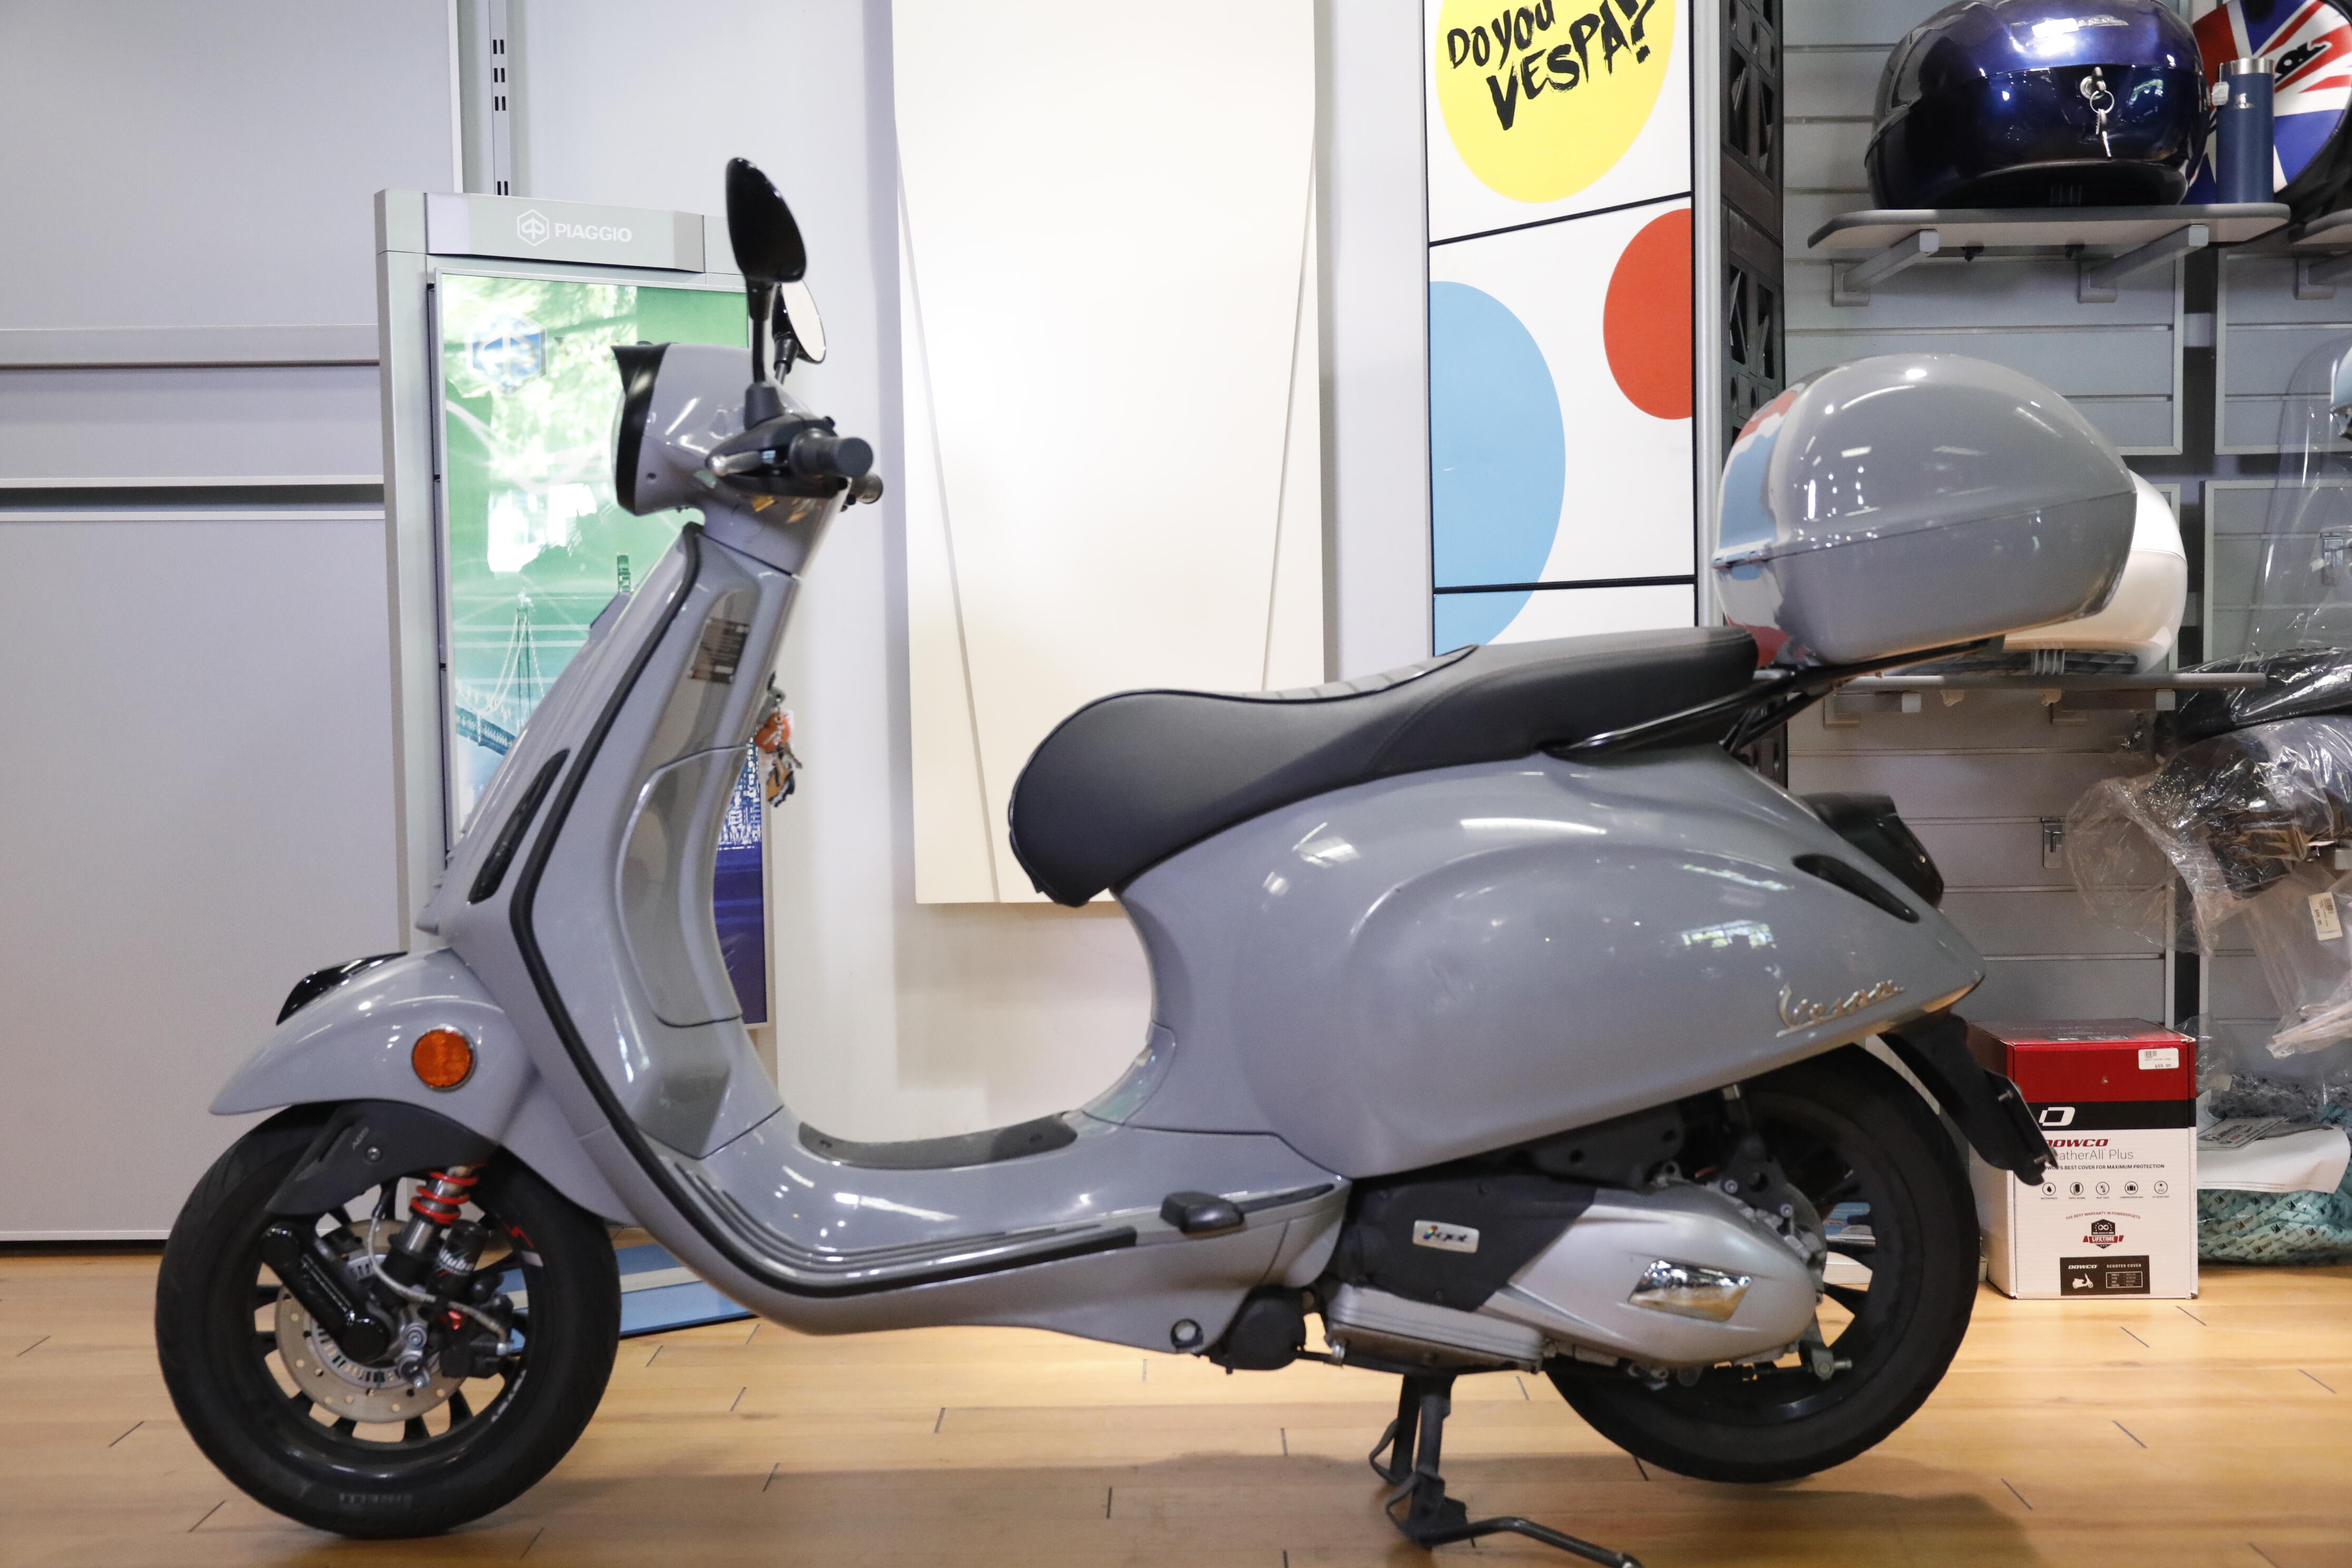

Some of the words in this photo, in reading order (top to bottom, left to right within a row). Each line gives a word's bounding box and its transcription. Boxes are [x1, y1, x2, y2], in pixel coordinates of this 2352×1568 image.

[554, 223, 632, 242] PIAGGIO
[2056, 1149, 2104, 1161] atherAll
[2109, 1148, 2134, 1160] Plus
